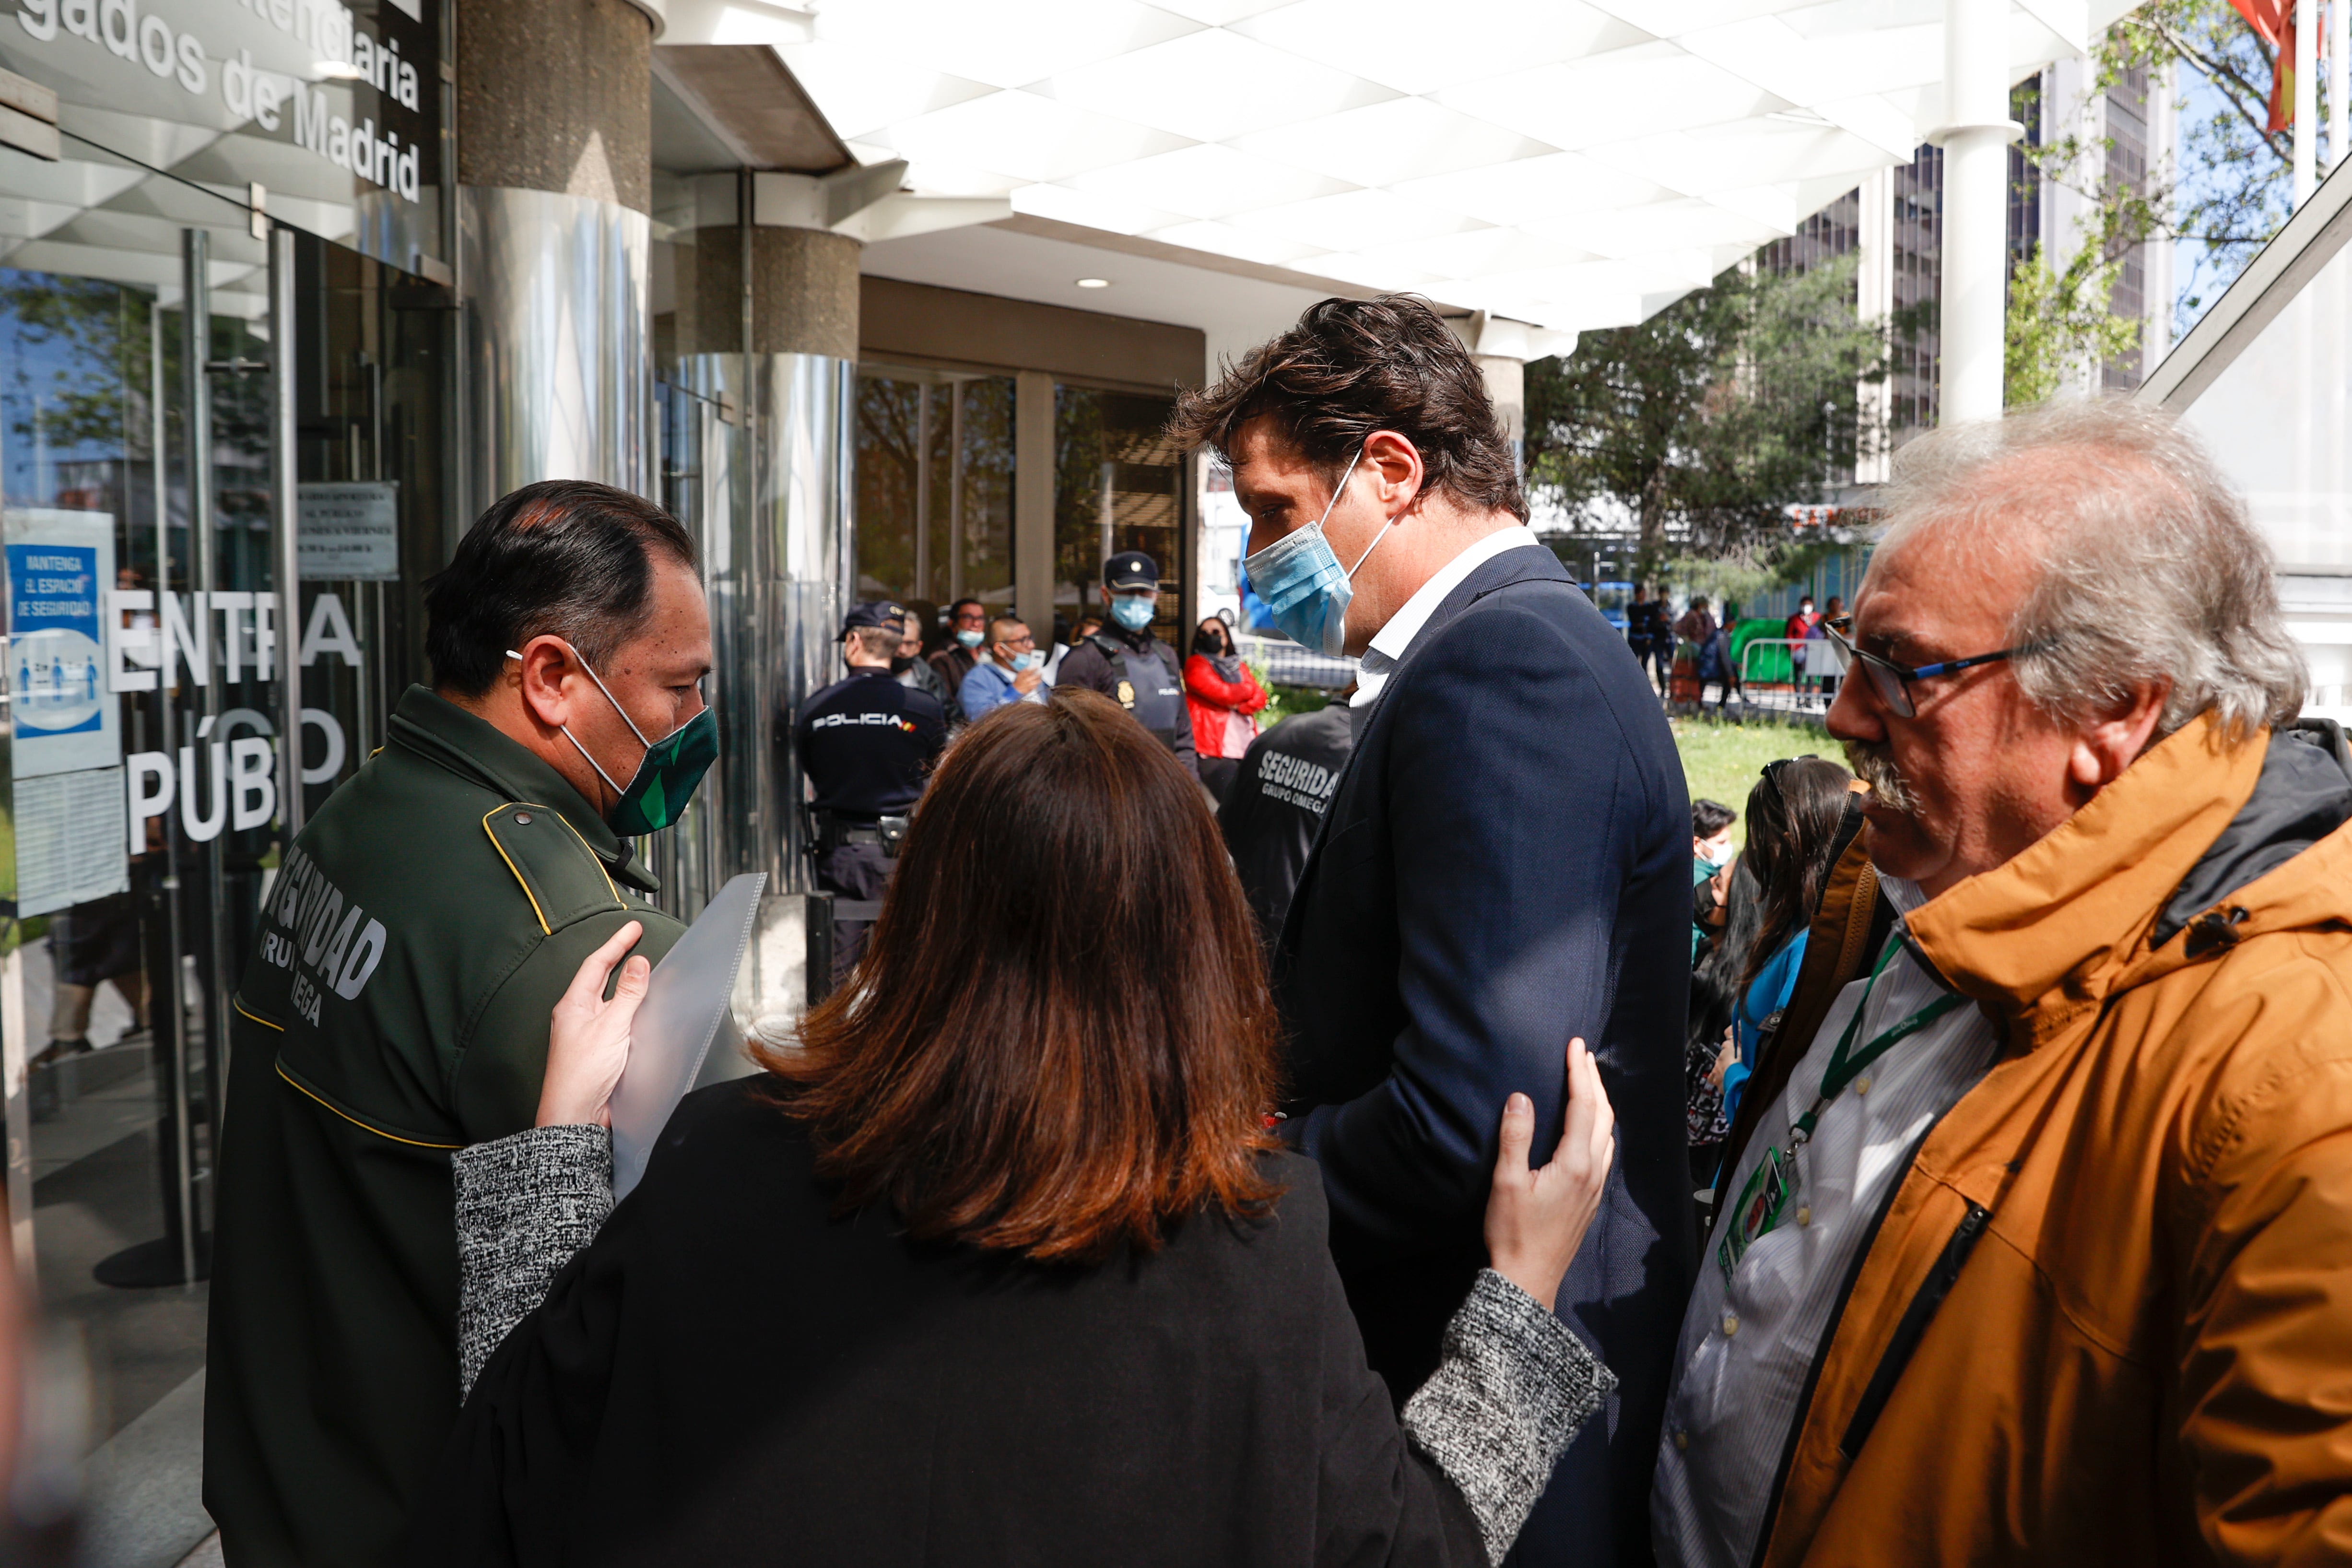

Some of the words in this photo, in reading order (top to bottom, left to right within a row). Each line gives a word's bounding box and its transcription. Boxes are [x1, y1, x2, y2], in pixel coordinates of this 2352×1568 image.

[222, 48, 281, 132] de
[293, 76, 420, 203] Madrid
[812, 713, 903, 731] POLICIA
[1262, 782, 1292, 802] GRUPO
